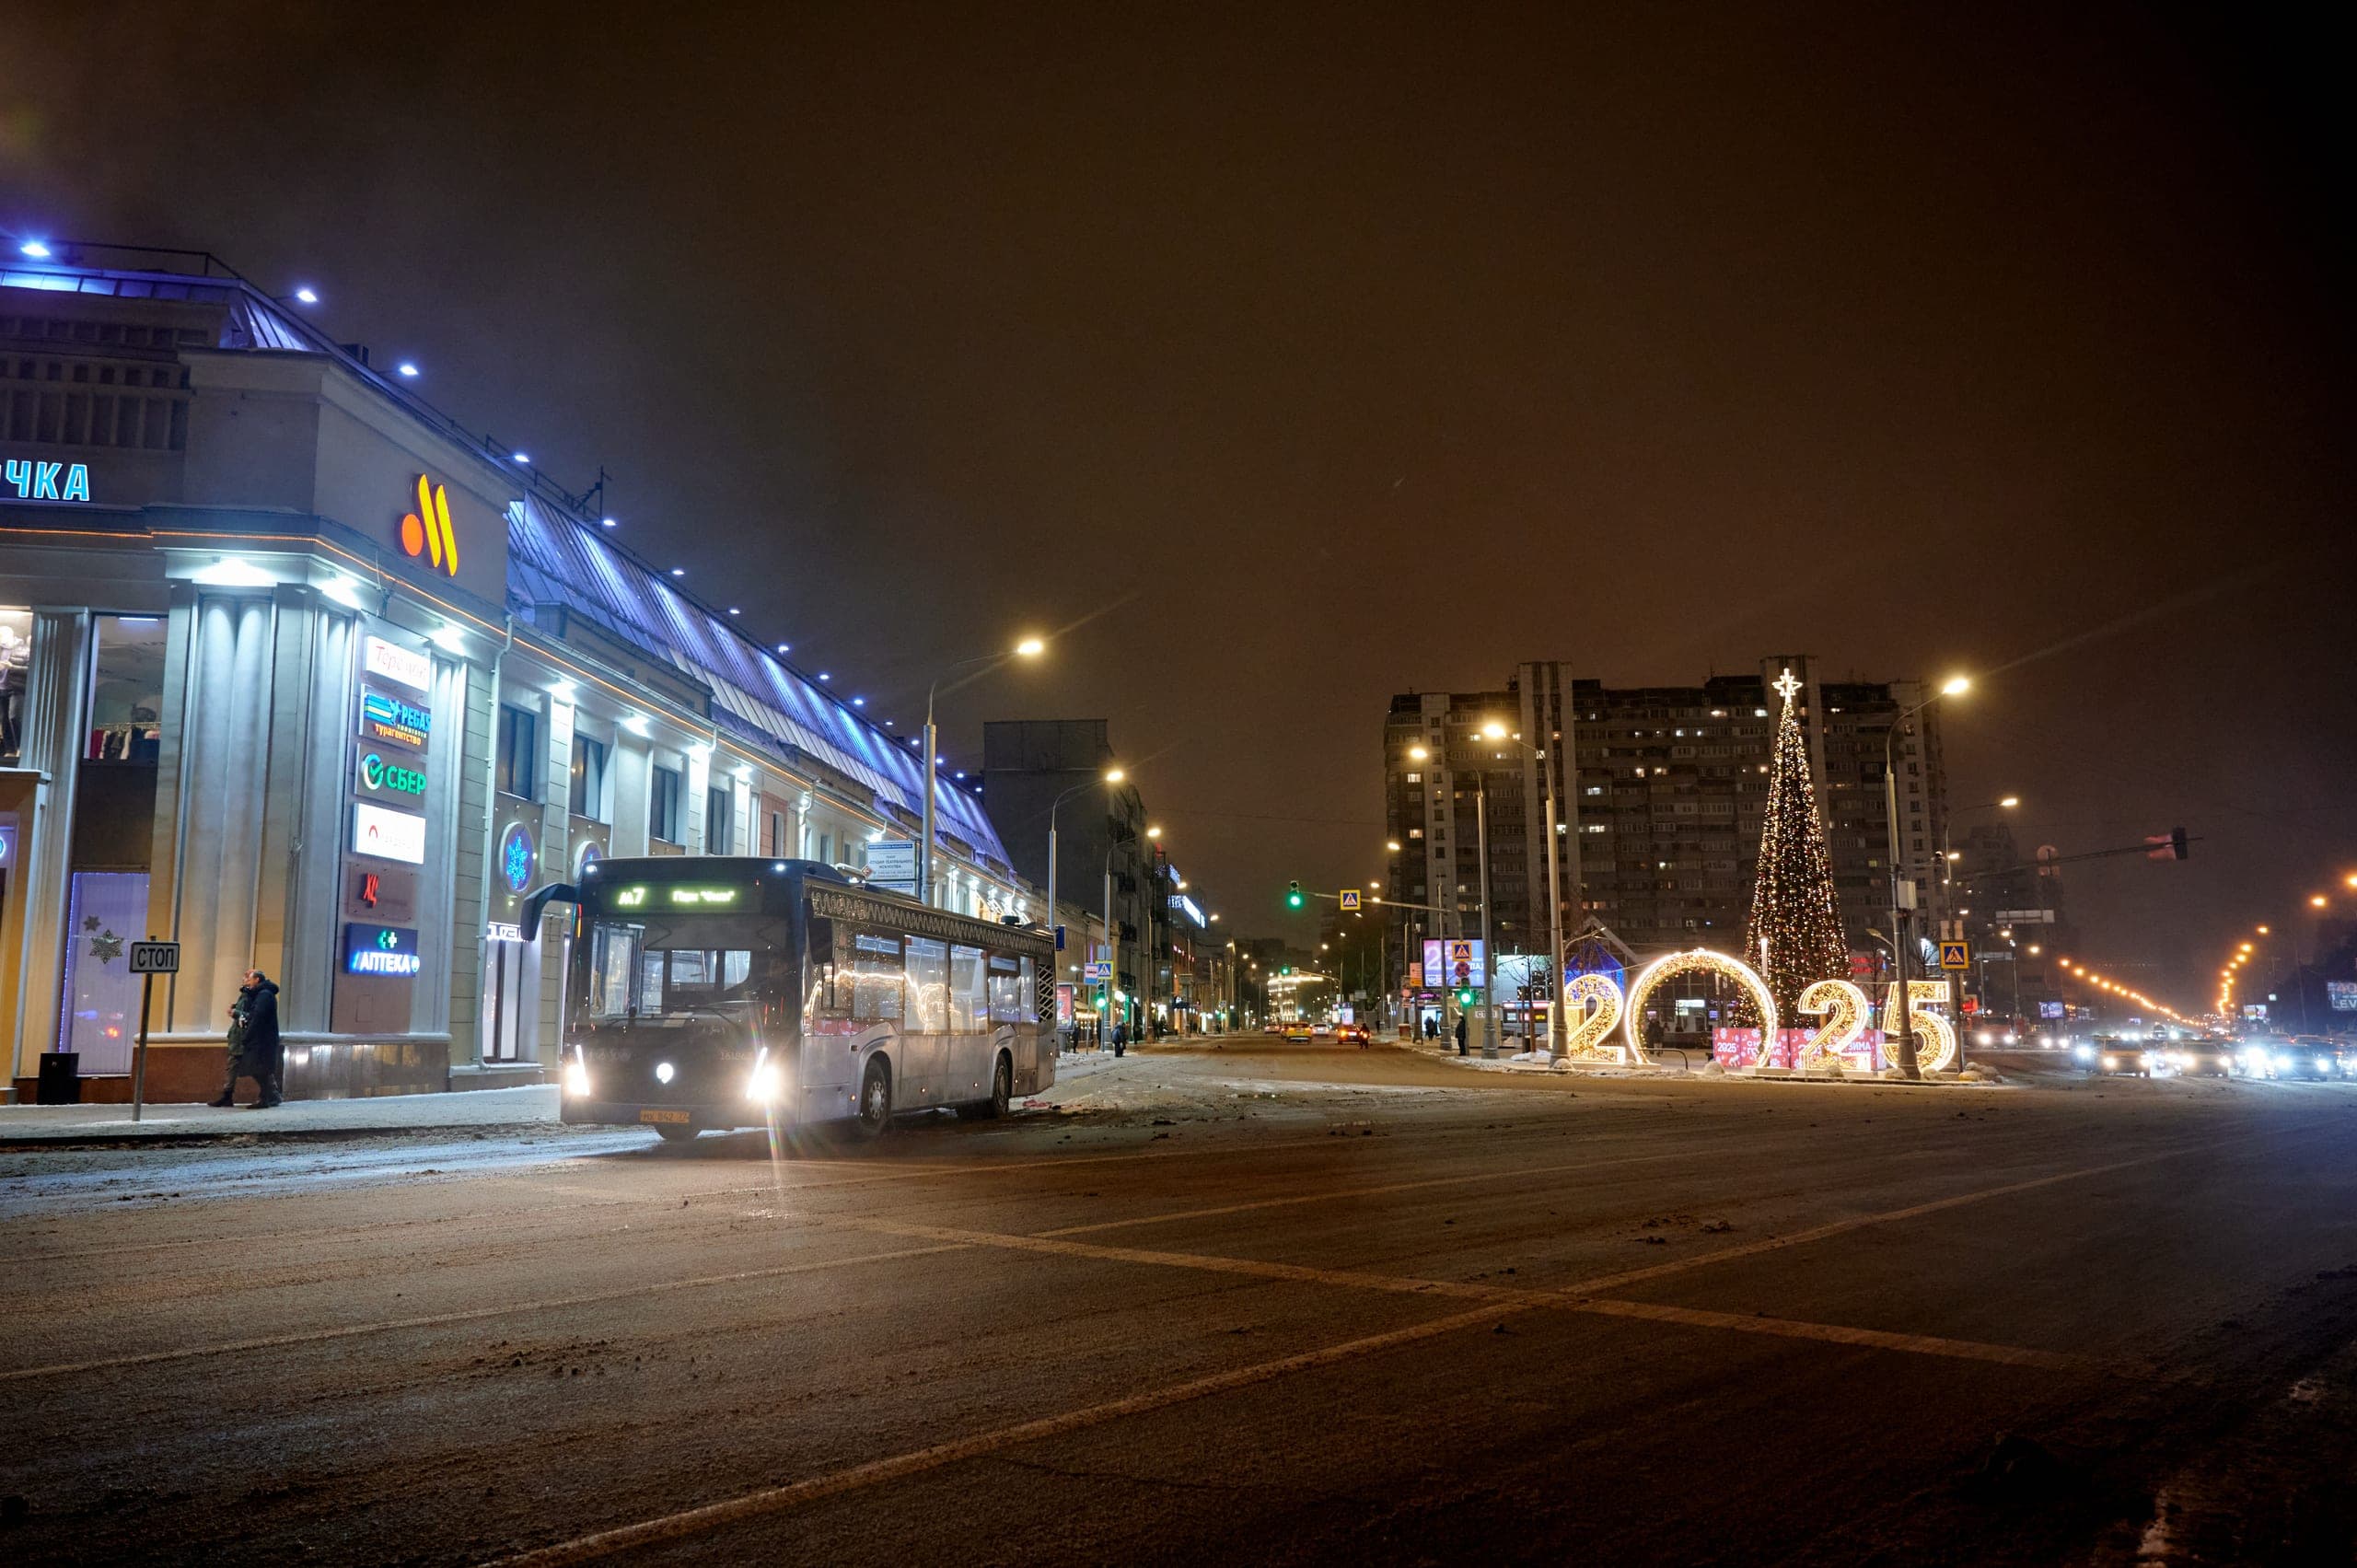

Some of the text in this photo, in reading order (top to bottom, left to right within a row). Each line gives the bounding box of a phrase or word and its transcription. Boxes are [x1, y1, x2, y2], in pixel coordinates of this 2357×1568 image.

[0, 459, 90, 502] ЧКА
[401, 705, 431, 732] PEGAS
[386, 765, 426, 795] СБЕР
[137, 947, 174, 968] СТОП
[360, 951, 411, 972] АПТЕКА
[1717, 1042, 1737, 1053] 2025
